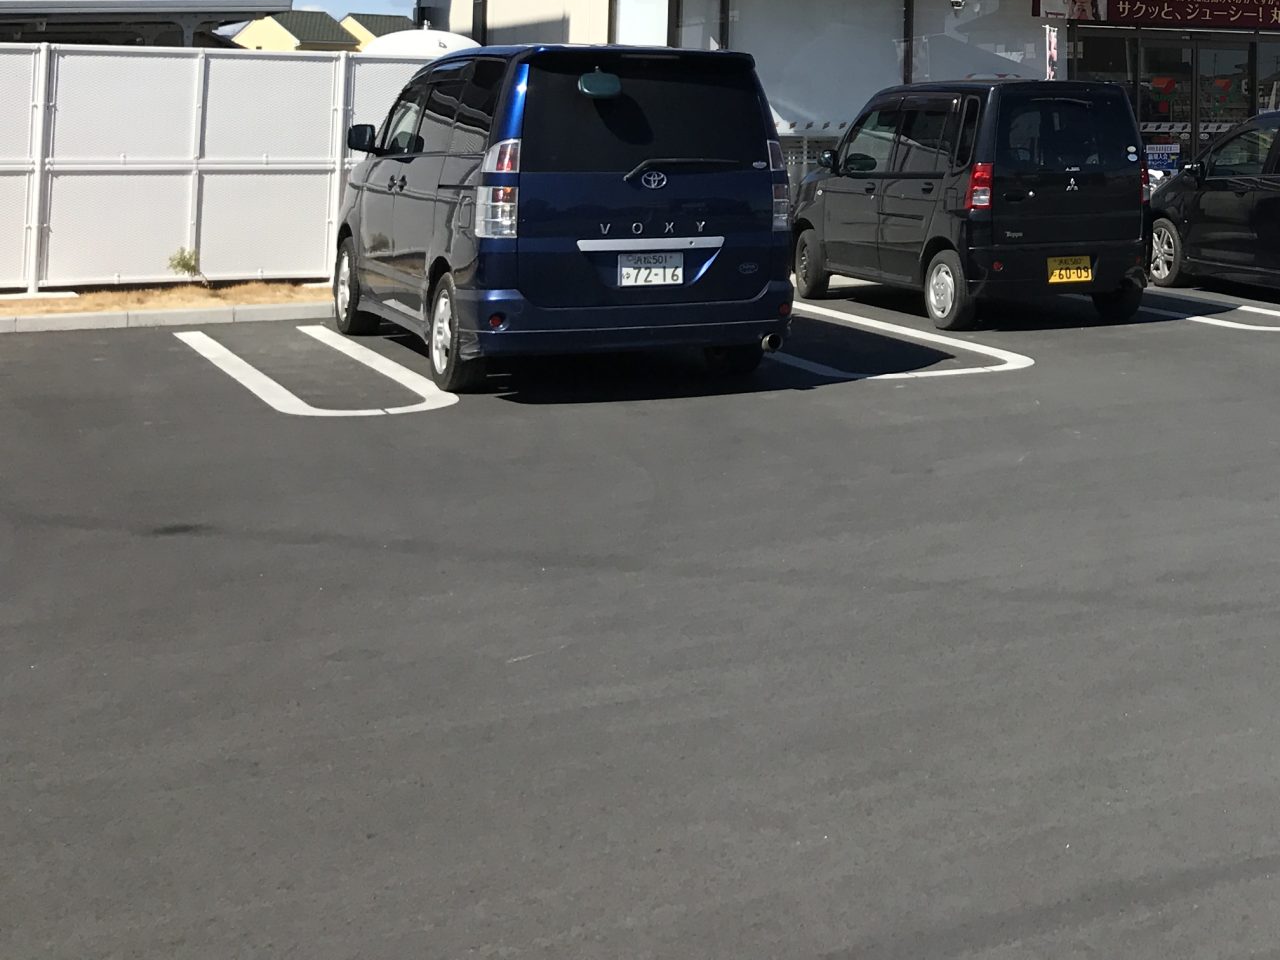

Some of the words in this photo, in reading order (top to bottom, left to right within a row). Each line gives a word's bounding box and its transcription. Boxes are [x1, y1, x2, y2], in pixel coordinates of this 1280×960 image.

[600, 221, 706, 235] VOXY
[632, 266, 680, 283] 72-16
[1058, 266, 1090, 280] 60-09
